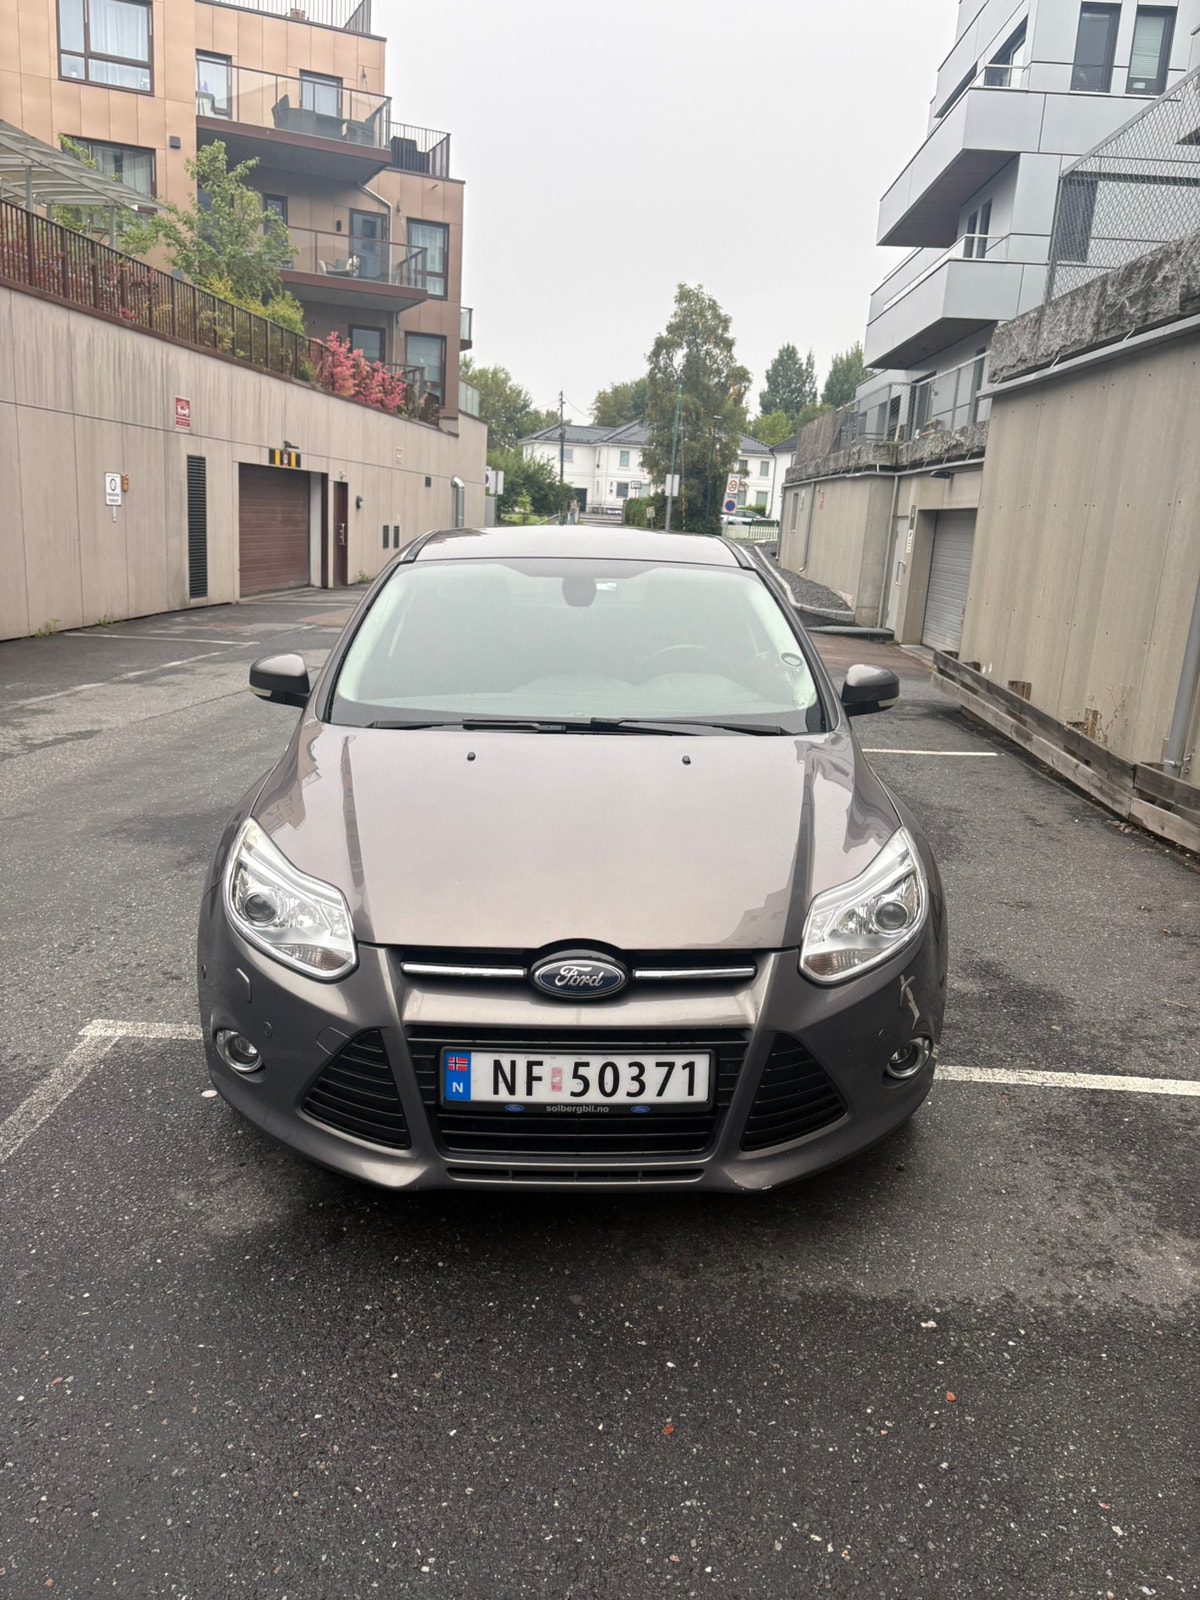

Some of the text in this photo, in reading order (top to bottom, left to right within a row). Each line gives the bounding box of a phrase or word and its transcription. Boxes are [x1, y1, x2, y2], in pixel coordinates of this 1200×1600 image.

[555, 966, 604, 987] Ford
[493, 1060, 696, 1098] NF 50371
[452, 1082, 463, 1093] N
[546, 1105, 609, 1114] solbergbil.no
